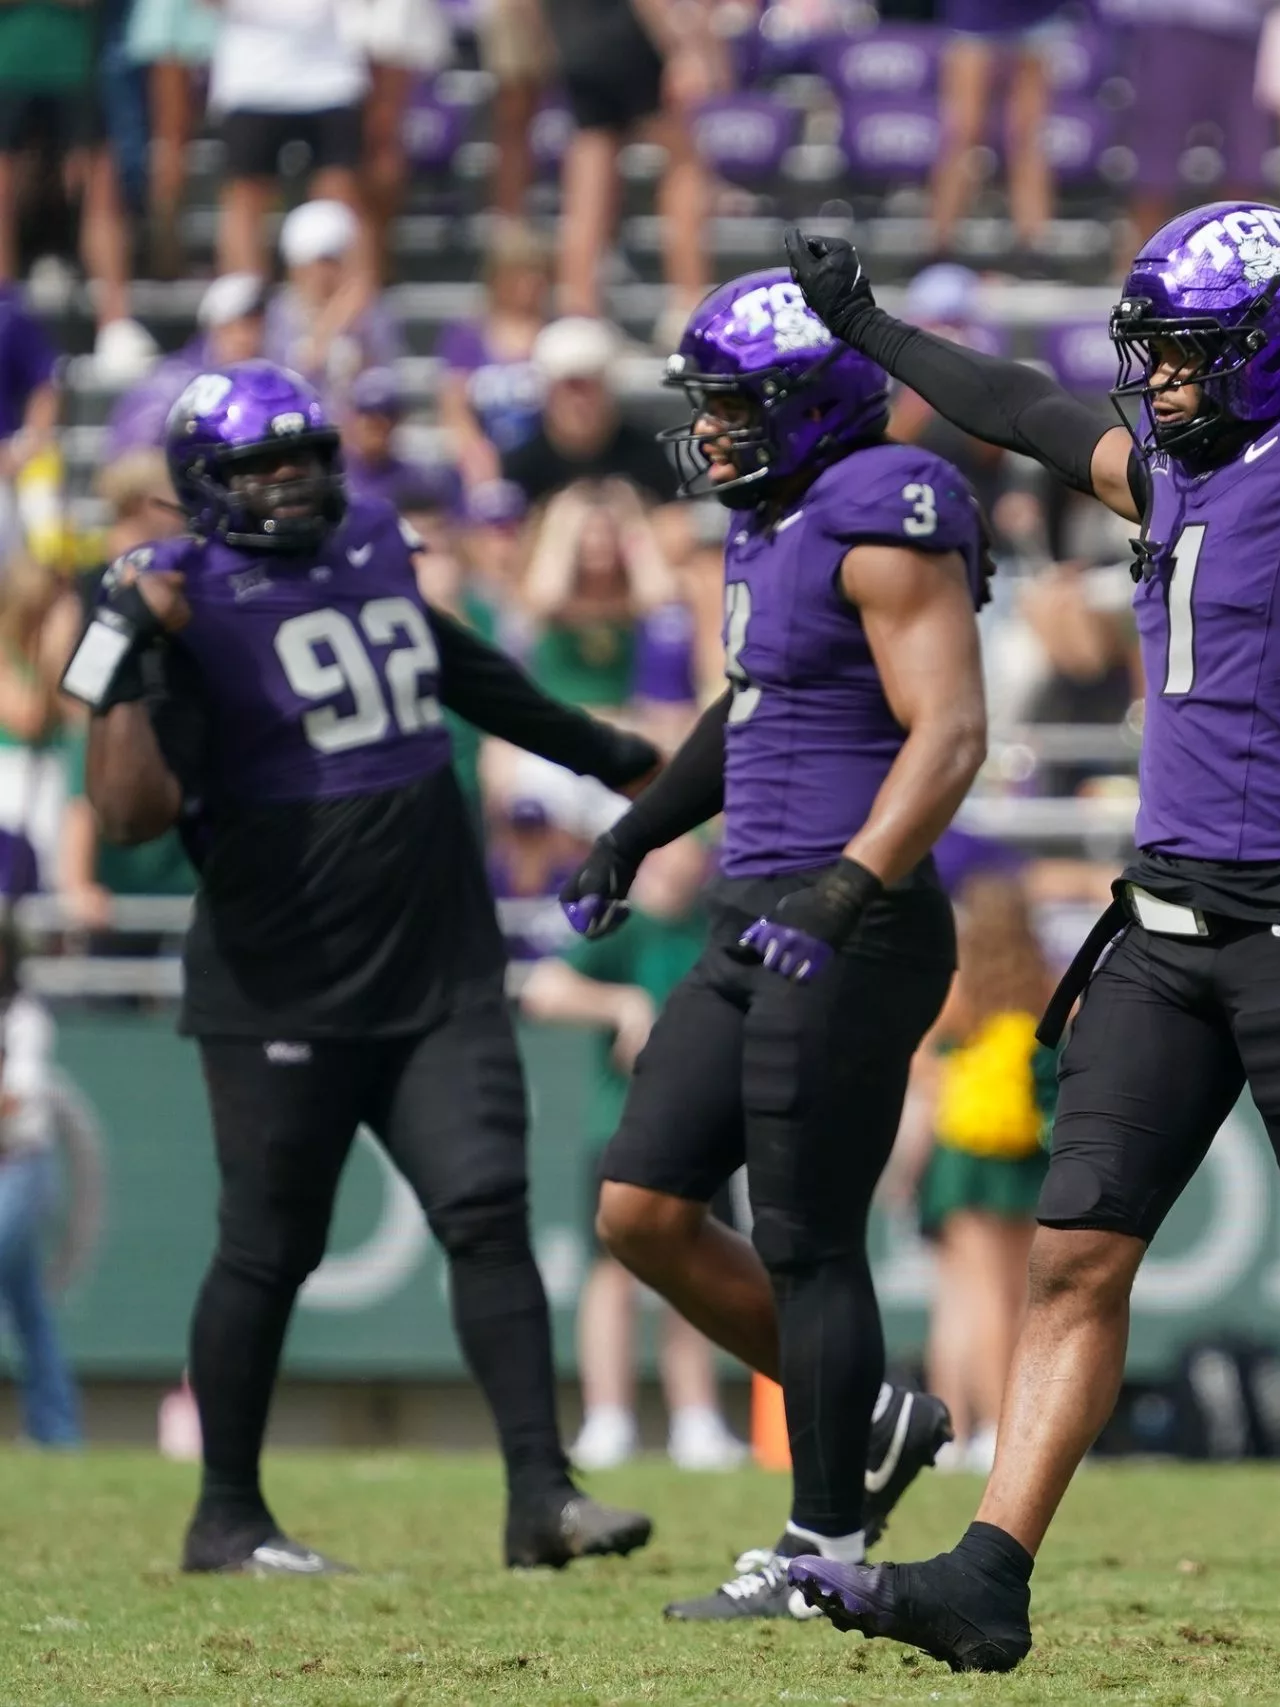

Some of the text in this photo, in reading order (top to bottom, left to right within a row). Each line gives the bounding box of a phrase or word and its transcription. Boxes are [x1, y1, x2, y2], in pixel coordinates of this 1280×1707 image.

[731, 282, 807, 337] TC
[902, 483, 938, 536] 3
[1162, 523, 1207, 695] 1
[274, 596, 443, 755] 92
